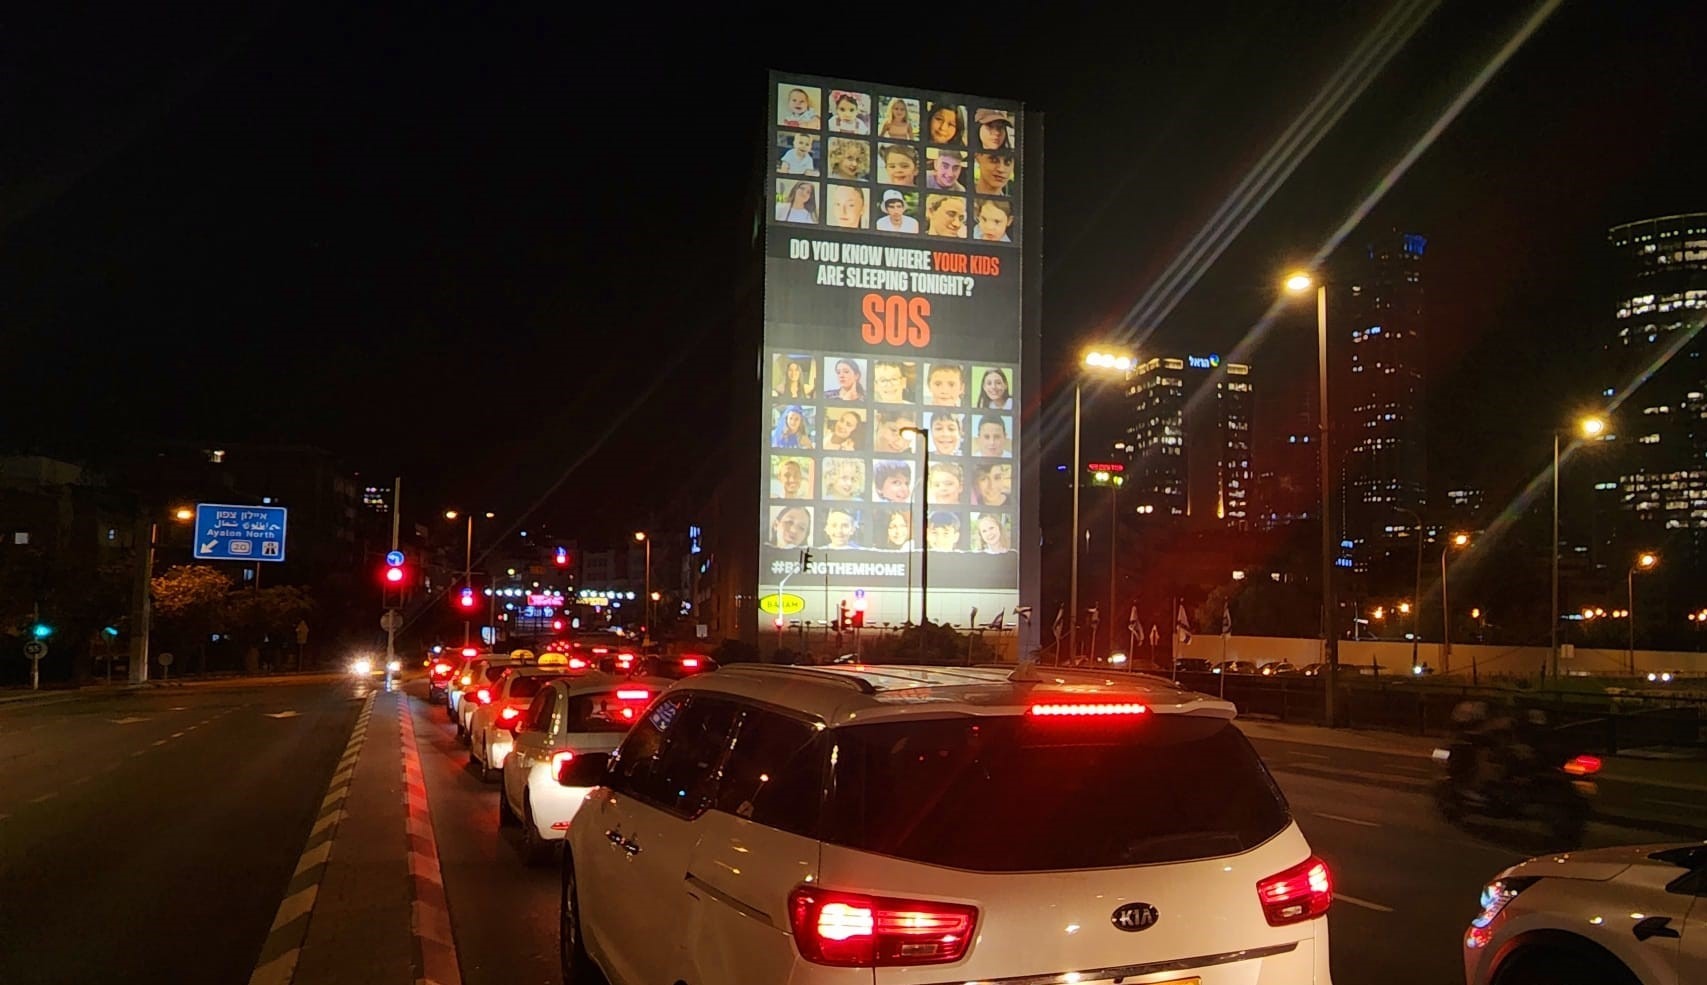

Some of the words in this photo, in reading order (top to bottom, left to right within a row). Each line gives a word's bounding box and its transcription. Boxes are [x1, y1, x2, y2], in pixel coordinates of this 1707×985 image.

[790, 238, 809, 260] DO
[812, 240, 839, 263] YOU
[842, 243, 883, 267] KNOW
[885, 247, 931, 270] WHERE
[933, 251, 967, 273] YOUR
[970, 255, 999, 276] KIDS
[817, 264, 844, 286] ARE
[846, 268, 908, 292] SLEEPING
[910, 273, 974, 297] TONIGHT?
[861, 293, 931, 348] SOS
[1189, 354, 1210, 368] הראל
[216, 511, 237, 520] צפון
[241, 511, 267, 520] איילון
[207, 529, 241, 538] Ayalon
[246, 530, 275, 539] North
[233, 543, 247, 551] 20
[771, 560, 905, 576] #BNGTHEMHOME
[1120, 909, 1153, 927] KIA
